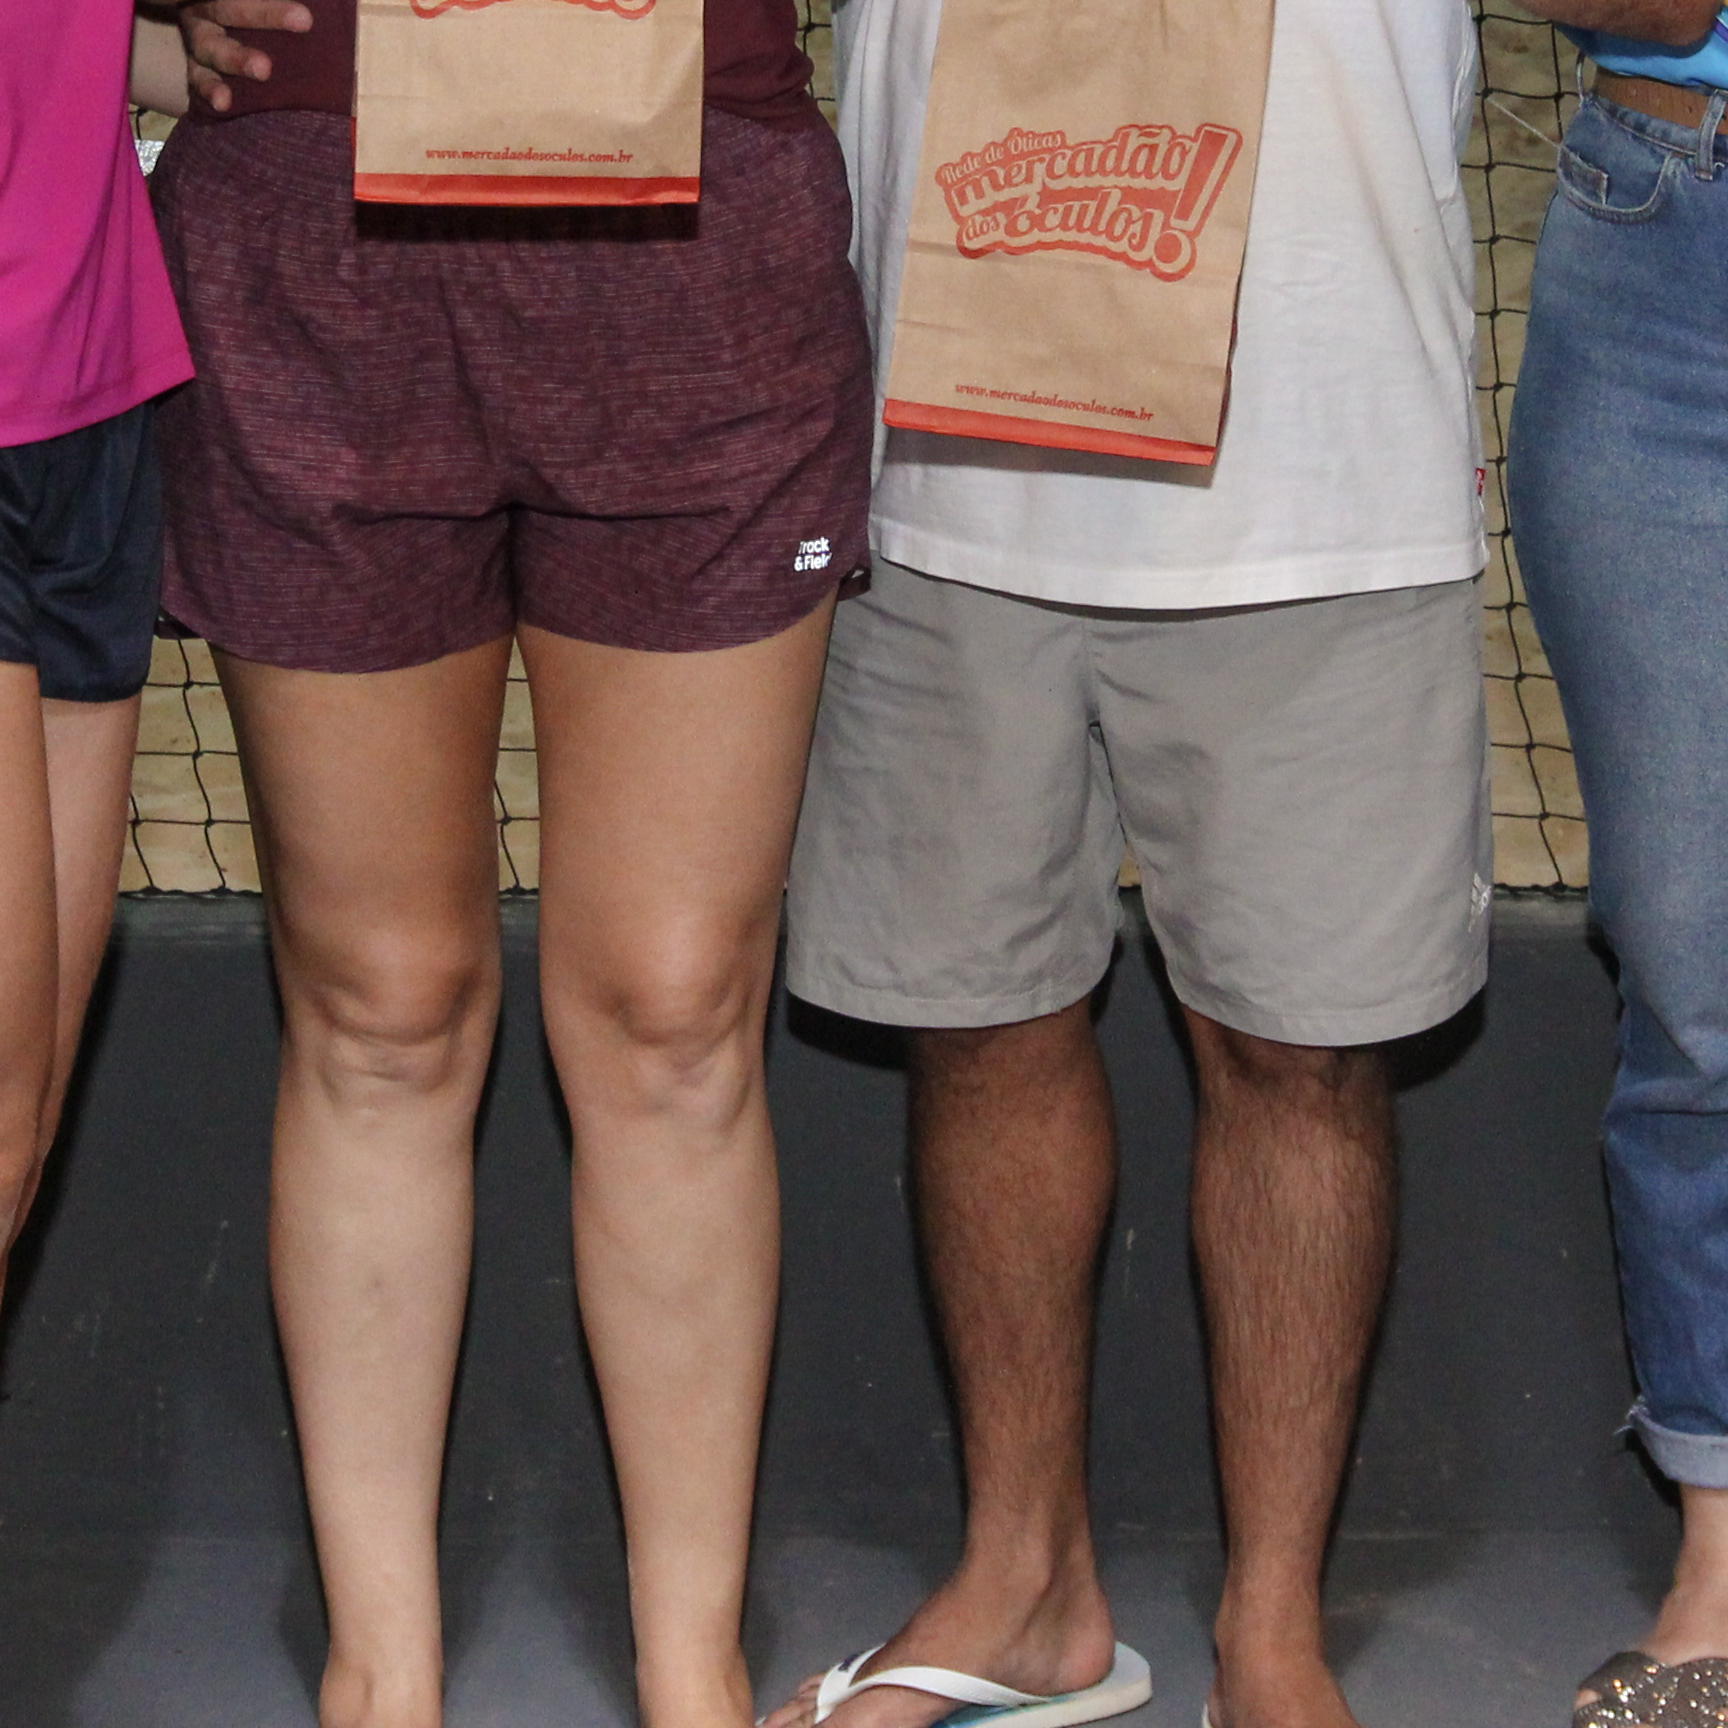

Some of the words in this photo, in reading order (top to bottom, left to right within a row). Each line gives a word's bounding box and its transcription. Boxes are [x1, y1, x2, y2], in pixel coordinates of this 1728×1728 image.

[425, 146, 634, 164] www.mercadaodosoculos.com.br
[941, 153, 981, 184] Rede
[984, 142, 1005, 165] de
[963, 213, 1002, 244] dos
[954, 382, 1155, 422] www.mercadaodosoculos.com.br
